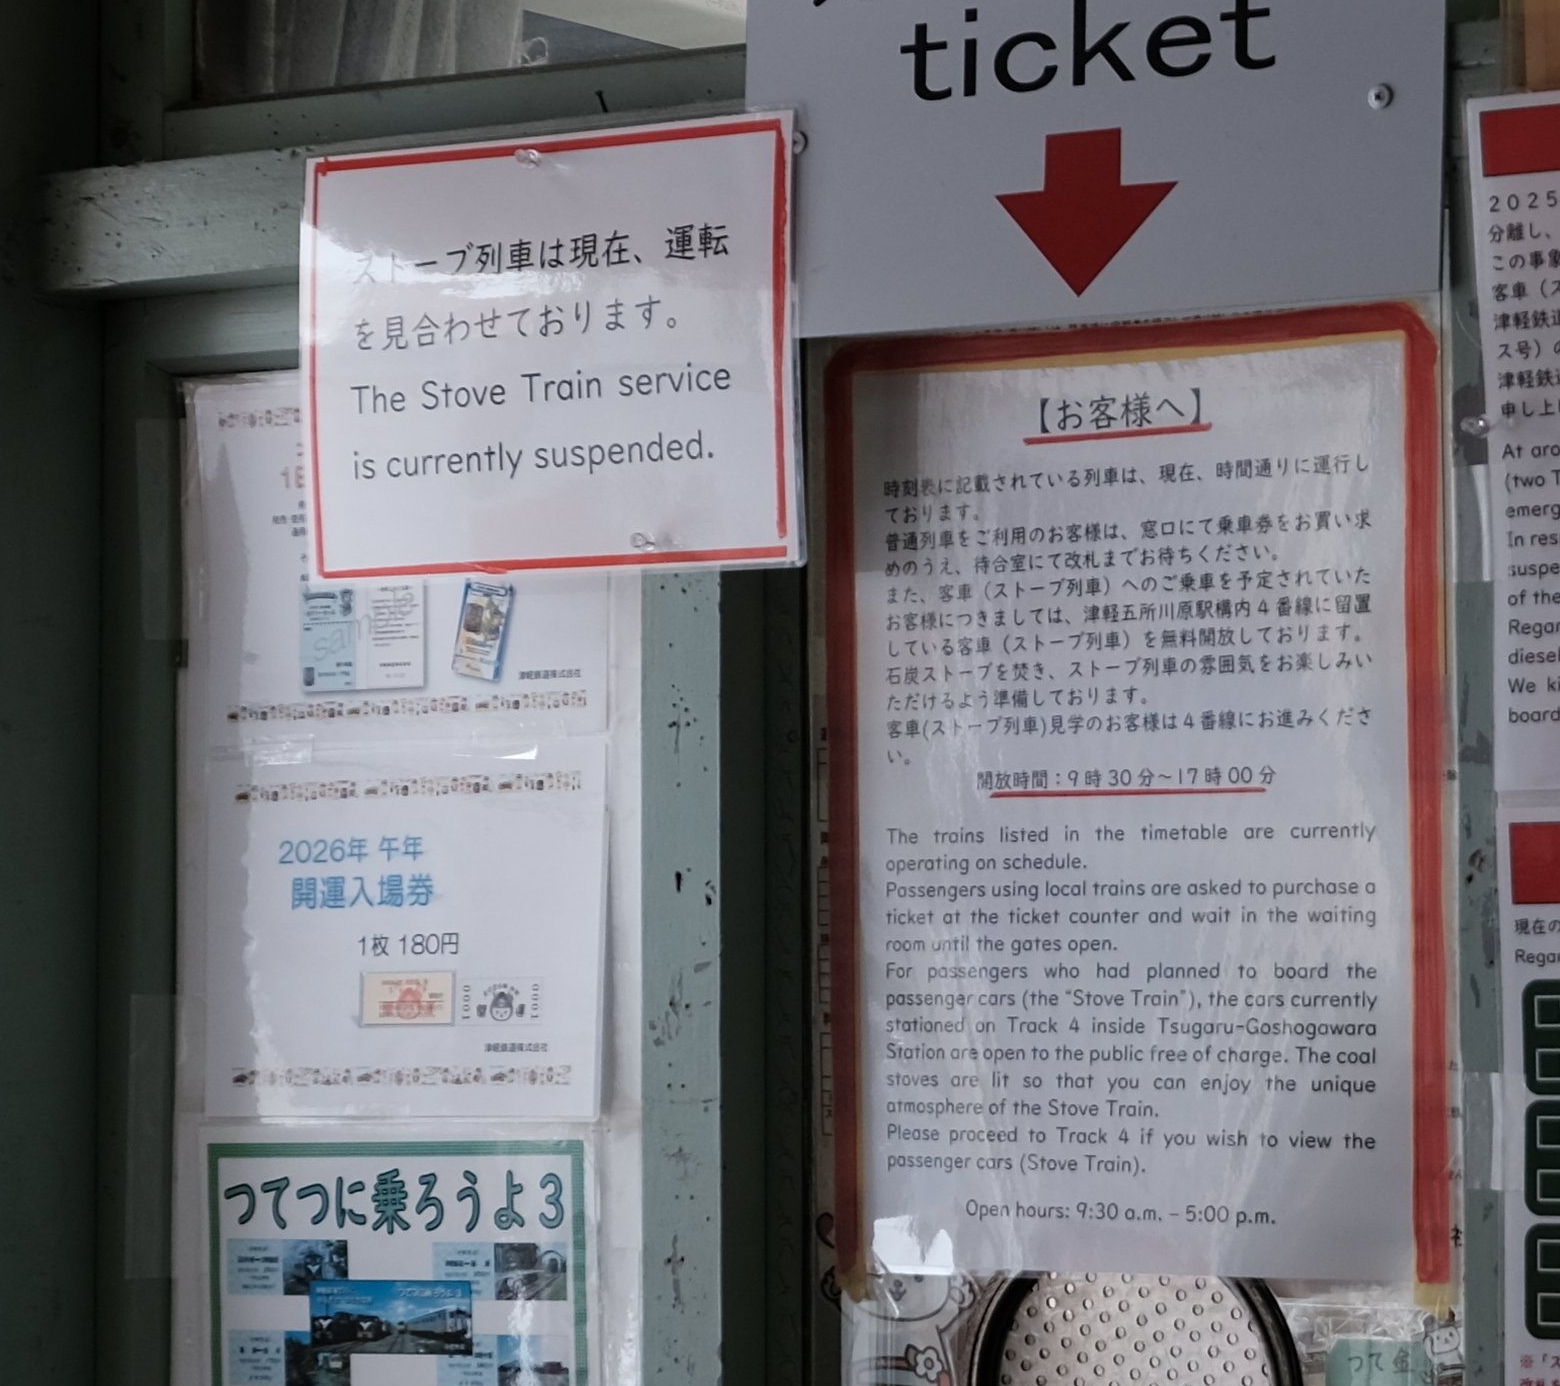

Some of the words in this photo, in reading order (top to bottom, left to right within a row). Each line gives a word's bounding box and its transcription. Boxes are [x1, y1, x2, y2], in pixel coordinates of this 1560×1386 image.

[354, 294, 678, 351] を見合わせております。
[350, 384, 405, 414] The
[422, 380, 505, 411] Stove
[520, 369, 601, 403] Train
[619, 361, 731, 397] service
[1040, 388, 1202, 434] 【お客様へ】
[354, 450, 375, 480] is
[387, 441, 522, 479] currently
[535, 428, 714, 475] suspended.
[1508, 588, 1527, 607] of
[886, 684, 1149, 711] ただけるよう準備しております。
[278, 837, 367, 865] 2026年
[378, 835, 424, 861] 午年
[290, 873, 435, 910] 開運入場券
[357, 933, 389, 957] 1枚
[397, 932, 459, 956] 180円
[224, 1168, 565, 1234] つてつに乗ろうよ3
[966, 1199, 1009, 1223] Open
[1016, 1200, 1070, 1220] hours:
[1076, 1201, 1118, 1222] 9:30
[1125, 1207, 1162, 1222] a.m.
[1186, 1204, 1229, 1223] 5:00
[1236, 1211, 1276, 1229] p.m.
